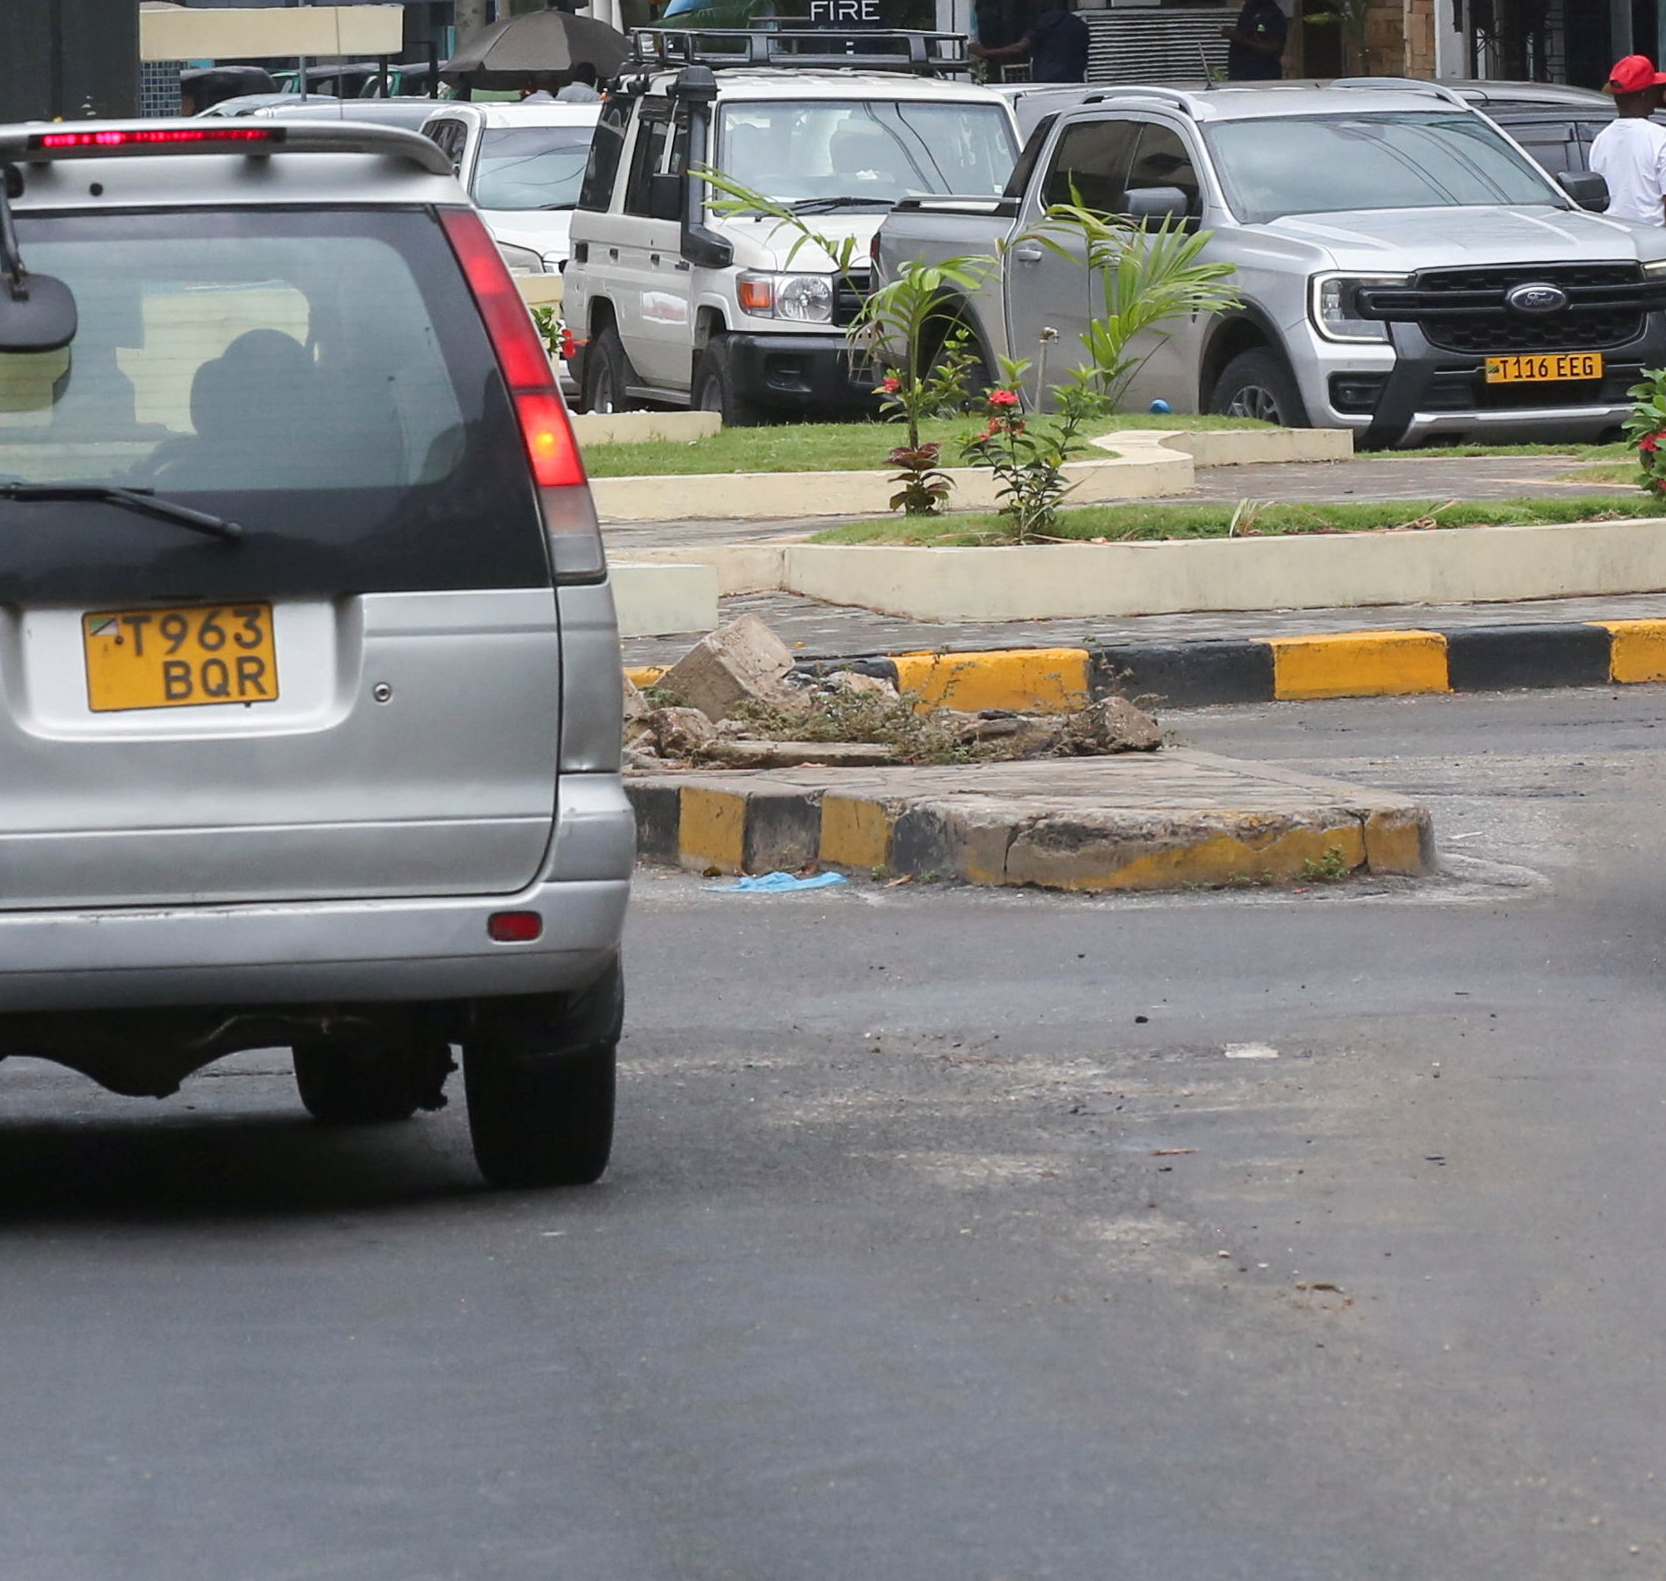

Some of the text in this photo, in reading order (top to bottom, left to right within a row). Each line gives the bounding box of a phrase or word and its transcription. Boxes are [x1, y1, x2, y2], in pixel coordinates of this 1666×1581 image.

[810, 0, 881, 22] FIRE
[1524, 291, 1555, 307] Ford
[1556, 356, 1594, 378] EEG
[121, 607, 264, 657] T963
[163, 655, 268, 701] BQR
